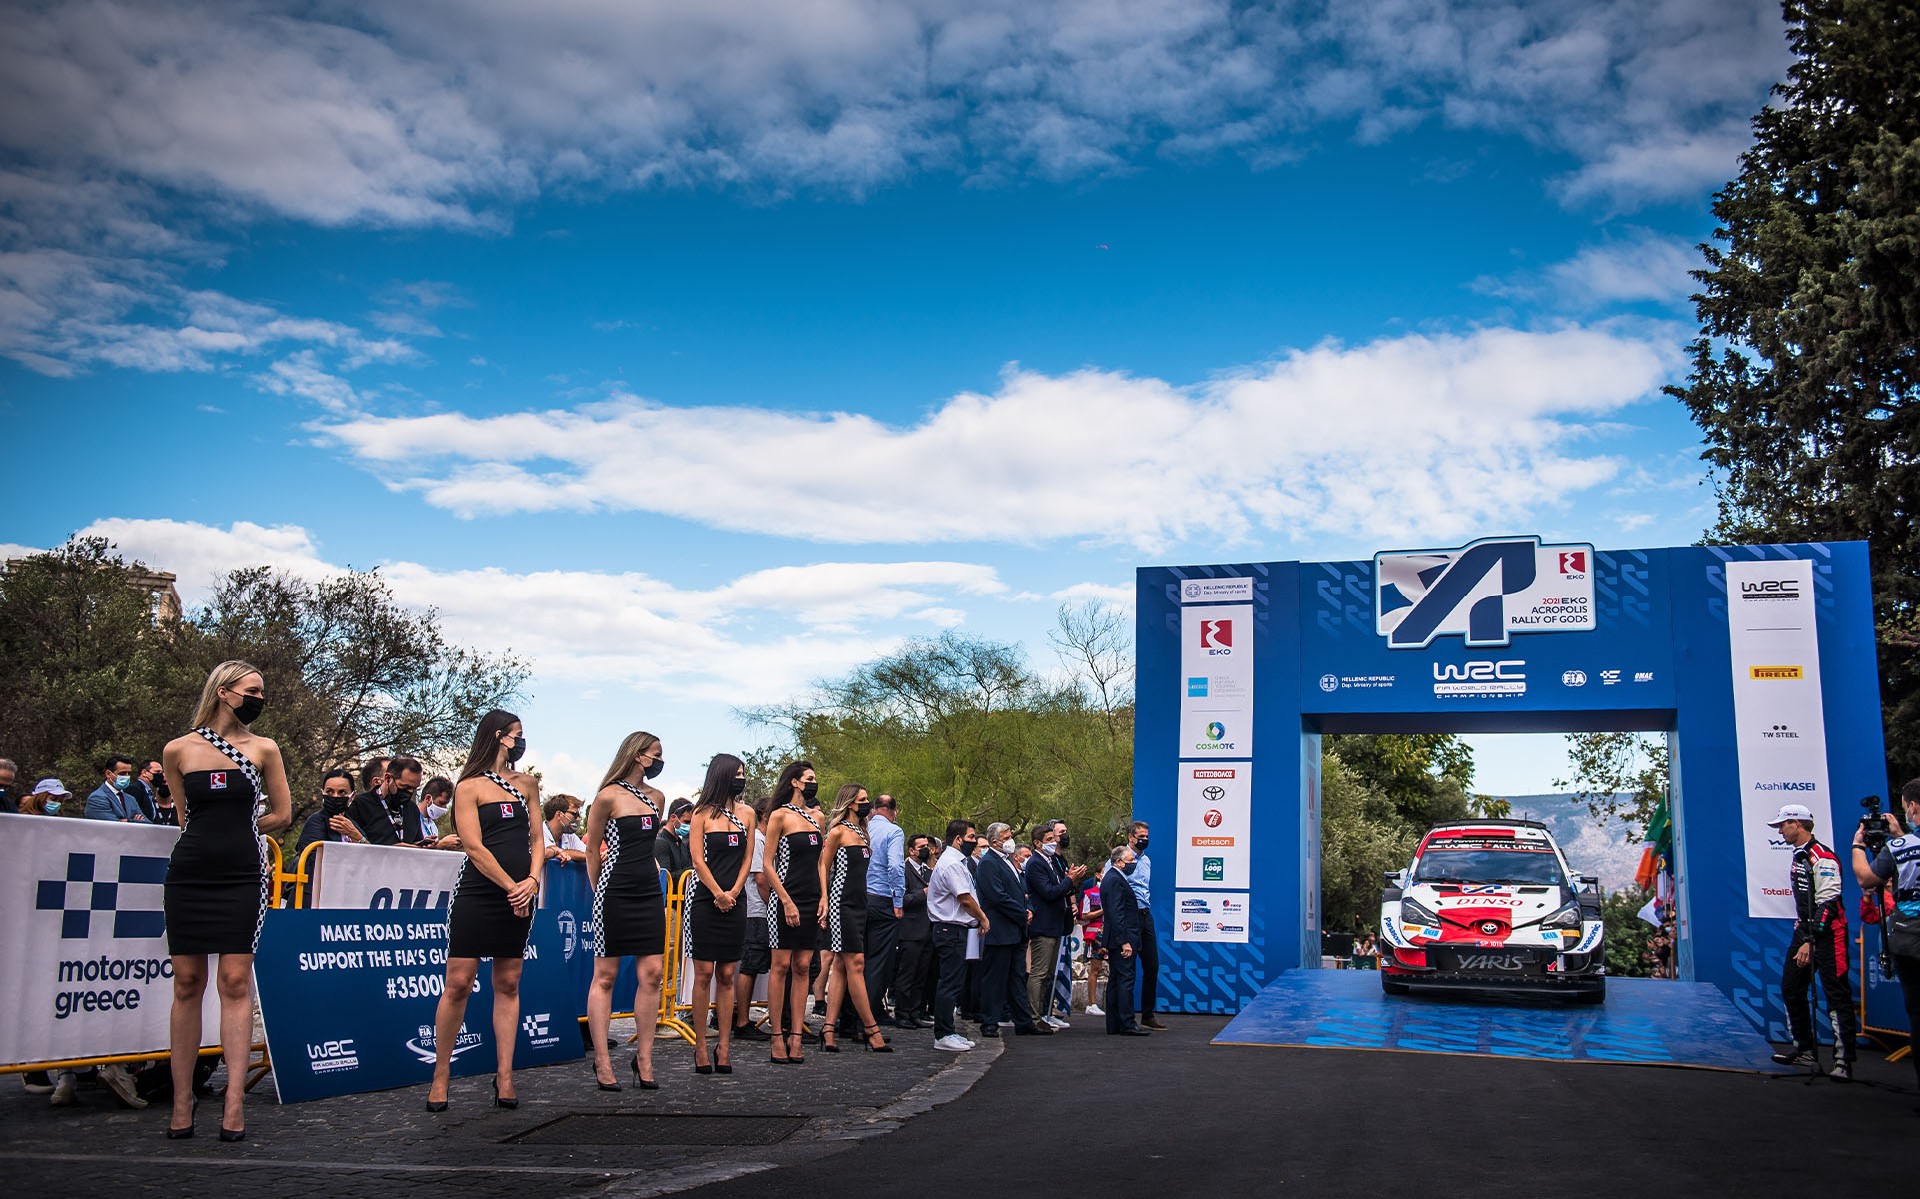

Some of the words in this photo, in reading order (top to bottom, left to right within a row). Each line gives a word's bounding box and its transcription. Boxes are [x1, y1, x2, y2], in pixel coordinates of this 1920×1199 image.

[1741, 580, 1799, 592] WRC
[1542, 597, 1560, 605] 2021
[1531, 605, 1588, 614] ACROPOLIS
[1511, 615, 1542, 624] RALLY
[1543, 615, 1557, 624] OF
[1559, 615, 1588, 623] GODS
[1209, 648, 1231, 656] EKO
[1433, 660, 1526, 681] WRC
[1754, 668, 1798, 678] PIRELLI
[1562, 673, 1585, 684] FIA
[1754, 782, 1816, 791] AsahiKASEI
[1204, 863, 1222, 874] Loop
[1456, 898, 1524, 907] DENSO
[320, 924, 362, 942] MAKE
[364, 923, 404, 941] ROAD
[1383, 916, 1404, 946] Panasonic
[1577, 923, 1601, 952] Panasonic
[299, 951, 364, 971] SUPPORT
[366, 950, 392, 968] THE
[394, 949, 427, 968] FIA'S
[58, 955, 175, 985] motorspo
[55, 988, 141, 1020] greece
[419, 1027, 431, 1037] FIA
[420, 1038, 433, 1047] FOR
[455, 1033, 481, 1046] SAFETY
[306, 1039, 357, 1060] WRC
